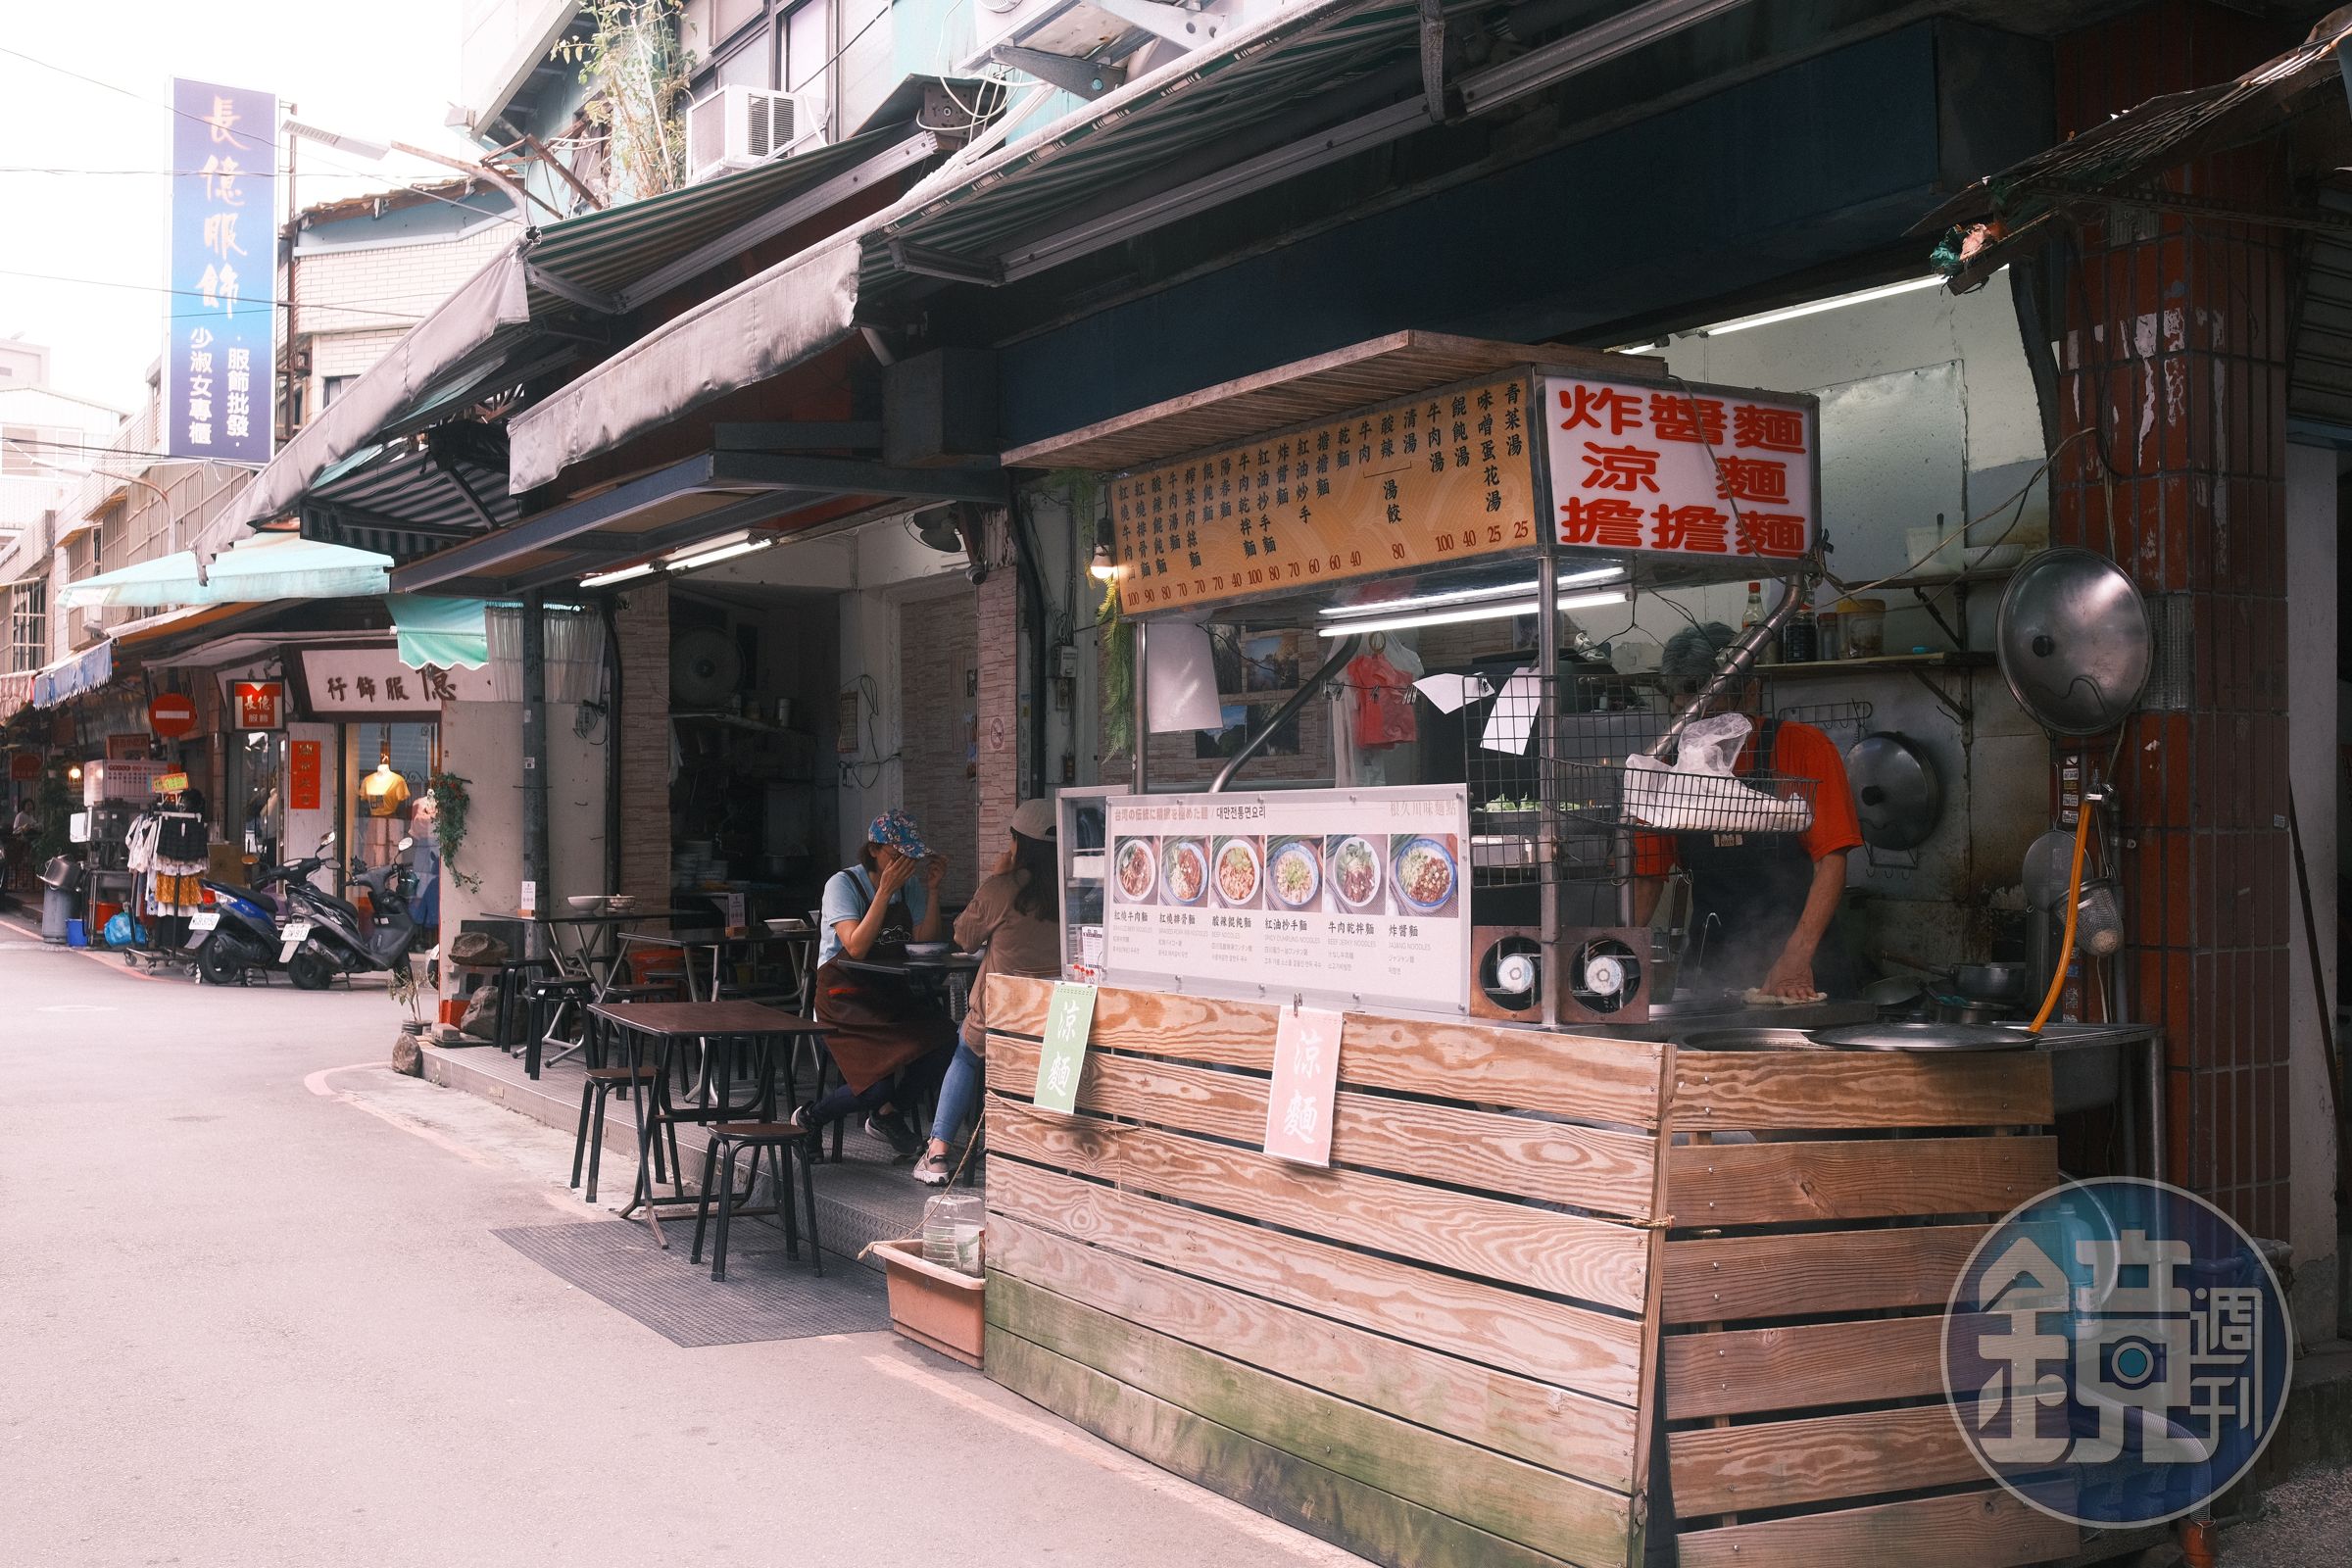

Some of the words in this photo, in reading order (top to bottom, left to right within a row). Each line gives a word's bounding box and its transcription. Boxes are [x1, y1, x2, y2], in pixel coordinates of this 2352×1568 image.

[196, 95, 251, 319] 長億服飾
[188, 326, 214, 446] 少淑女專櫃
[1505, 383, 1522, 457] 青菜湯
[1559, 385, 1806, 454] 炸醬麵
[1337, 426, 1350, 470] 乾麵
[1358, 420, 1372, 465] 牛肉
[1380, 414, 1395, 459] 酸辣
[1403, 409, 1417, 455] 清湯
[1427, 402, 1445, 473] 牛肉湯
[1451, 396, 1470, 467] 餛飩湯
[1477, 389, 1501, 513] 味噌蛋花湯
[1202, 463, 1214, 524] 餛飩麵
[1220, 457, 1232, 520] 陽春麵
[1239, 453, 1257, 560] 牛肉乾拌麵
[1257, 449, 1276, 556] 紅油抄手麵
[1276, 443, 1290, 508] 炸醬麵
[1384, 478, 1402, 524] 湯餃
[1135, 481, 1151, 580] 紅燒排骨麵
[1152, 475, 1167, 575] 酸辣餛飩麵
[1168, 471, 1182, 552] 牛肉湯麵
[1185, 467, 1201, 569] 榨菜肉絲麵
[1560, 497, 1806, 558] 擔擔麵
[1128, 593, 1140, 606] 100
[1145, 589, 1154, 603] 90
[1161, 586, 1171, 600] 80
[1177, 583, 1188, 597] 70
[1195, 580, 1205, 594] 70
[1213, 576, 1224, 590] 70
[1232, 572, 1243, 588] 40
[1248, 568, 1262, 584] 100
[1269, 565, 1280, 580] 80
[1288, 563, 1299, 577] 70
[1308, 558, 1320, 573] 60
[1330, 555, 1341, 570] 60
[1350, 551, 1361, 566] 40
[1393, 543, 1405, 560] 80
[1436, 533, 1454, 552] 100
[1463, 530, 1476, 547] 40
[1488, 525, 1501, 543] 25
[1514, 520, 1528, 539] 25
[245, 695, 271, 710] 長億
[327, 663, 491, 703] 億服飾行
[1217, 806, 1266, 819] 대만전통면요리
[1113, 909, 1148, 922] 紅燒牛肉麵
[1328, 920, 1374, 935] 牛肉乾拌麵
[1389, 924, 1418, 937] 炸醬麵
[1048, 1000, 1080, 1097] 涼麵
[1283, 1028, 1323, 1144] 涼麵
